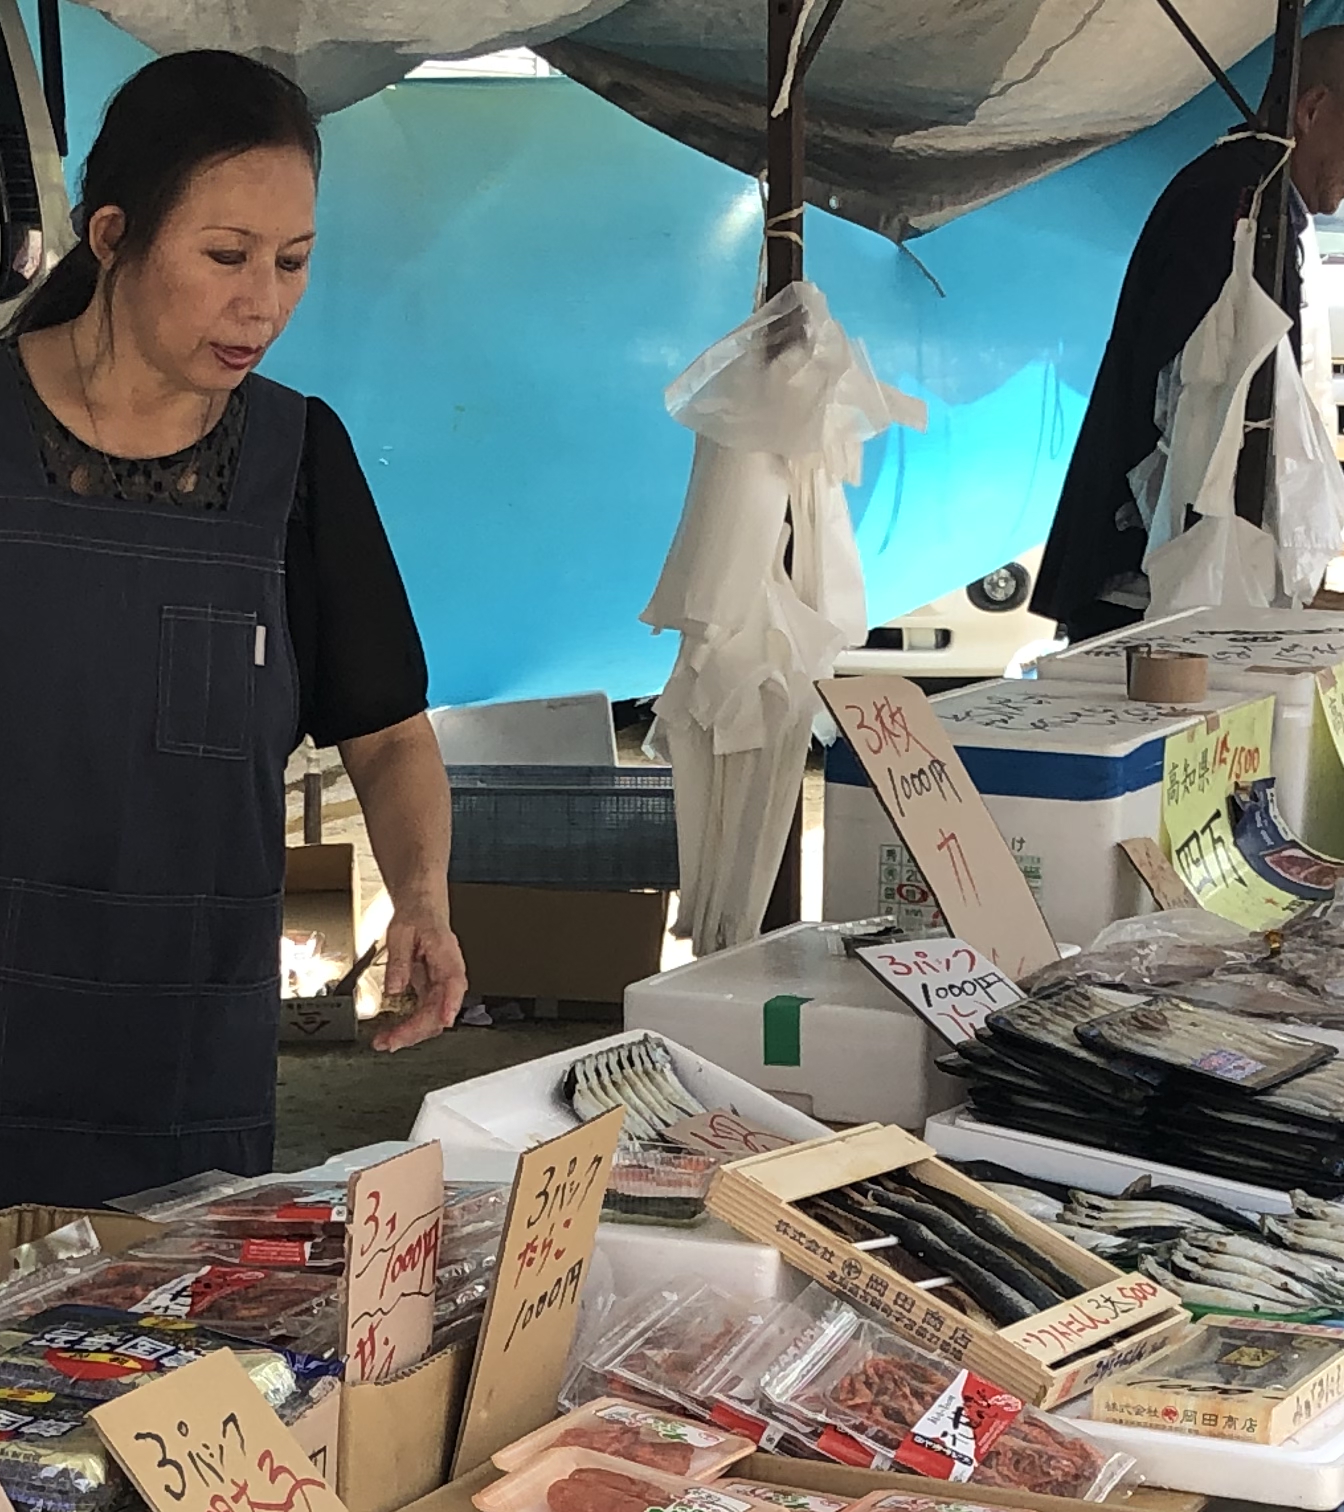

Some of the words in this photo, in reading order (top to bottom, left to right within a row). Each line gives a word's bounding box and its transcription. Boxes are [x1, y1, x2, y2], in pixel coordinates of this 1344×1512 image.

[887, 758, 963, 818] 1000円
[921, 971, 1029, 1008] 1000円
[526, 1156, 604, 1229] 3パック
[774, 1217, 836, 1264] 株式会社
[503, 1257, 585, 1353] 1000円
[133, 1412, 247, 1502] 3パック
